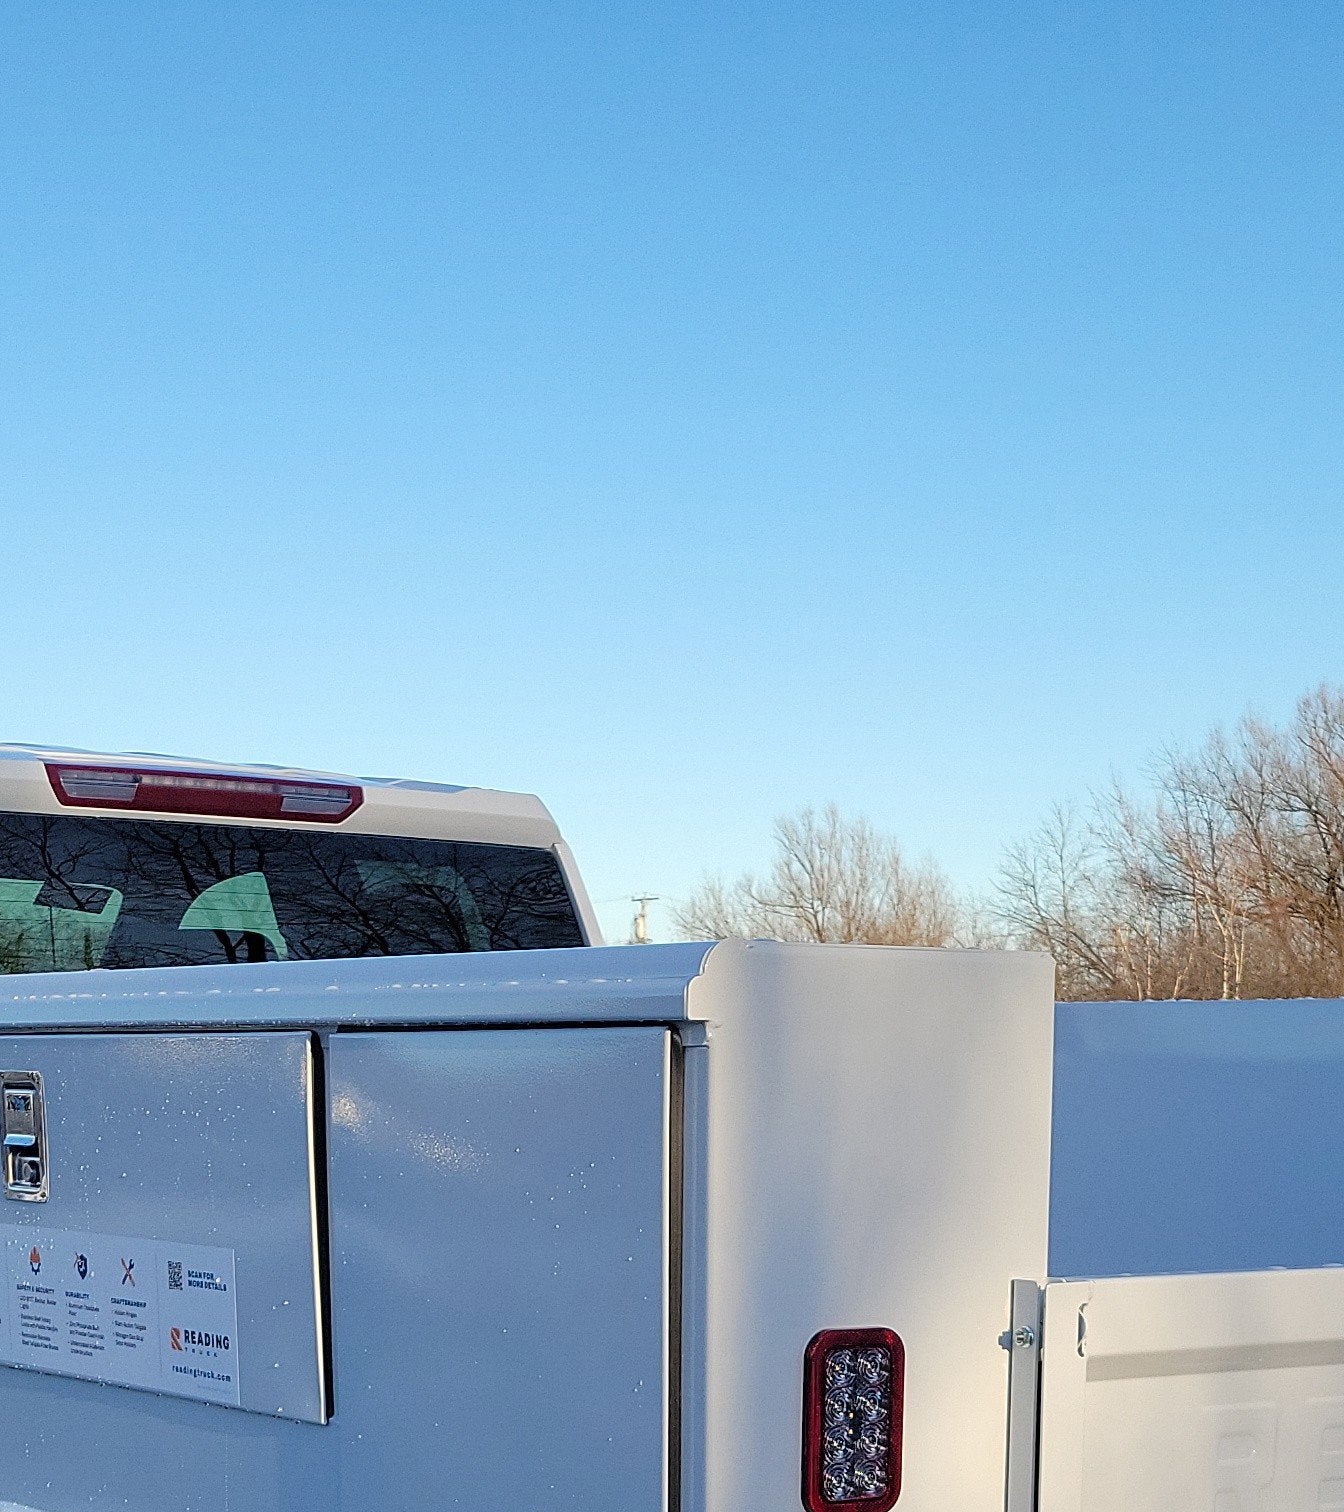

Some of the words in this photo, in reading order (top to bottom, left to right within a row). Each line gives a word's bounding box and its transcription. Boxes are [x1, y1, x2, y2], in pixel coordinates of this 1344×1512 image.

[187, 1270, 202, 1279] SCAN
[203, 1272, 214, 1280] FOR
[187, 1279, 203, 1288] MORE
[204, 1281, 227, 1292] DETAILS
[65, 1291, 90, 1300] DURABILITY
[184, 1329, 230, 1351] READING
[172, 1364, 232, 1384] readingtruck.com
